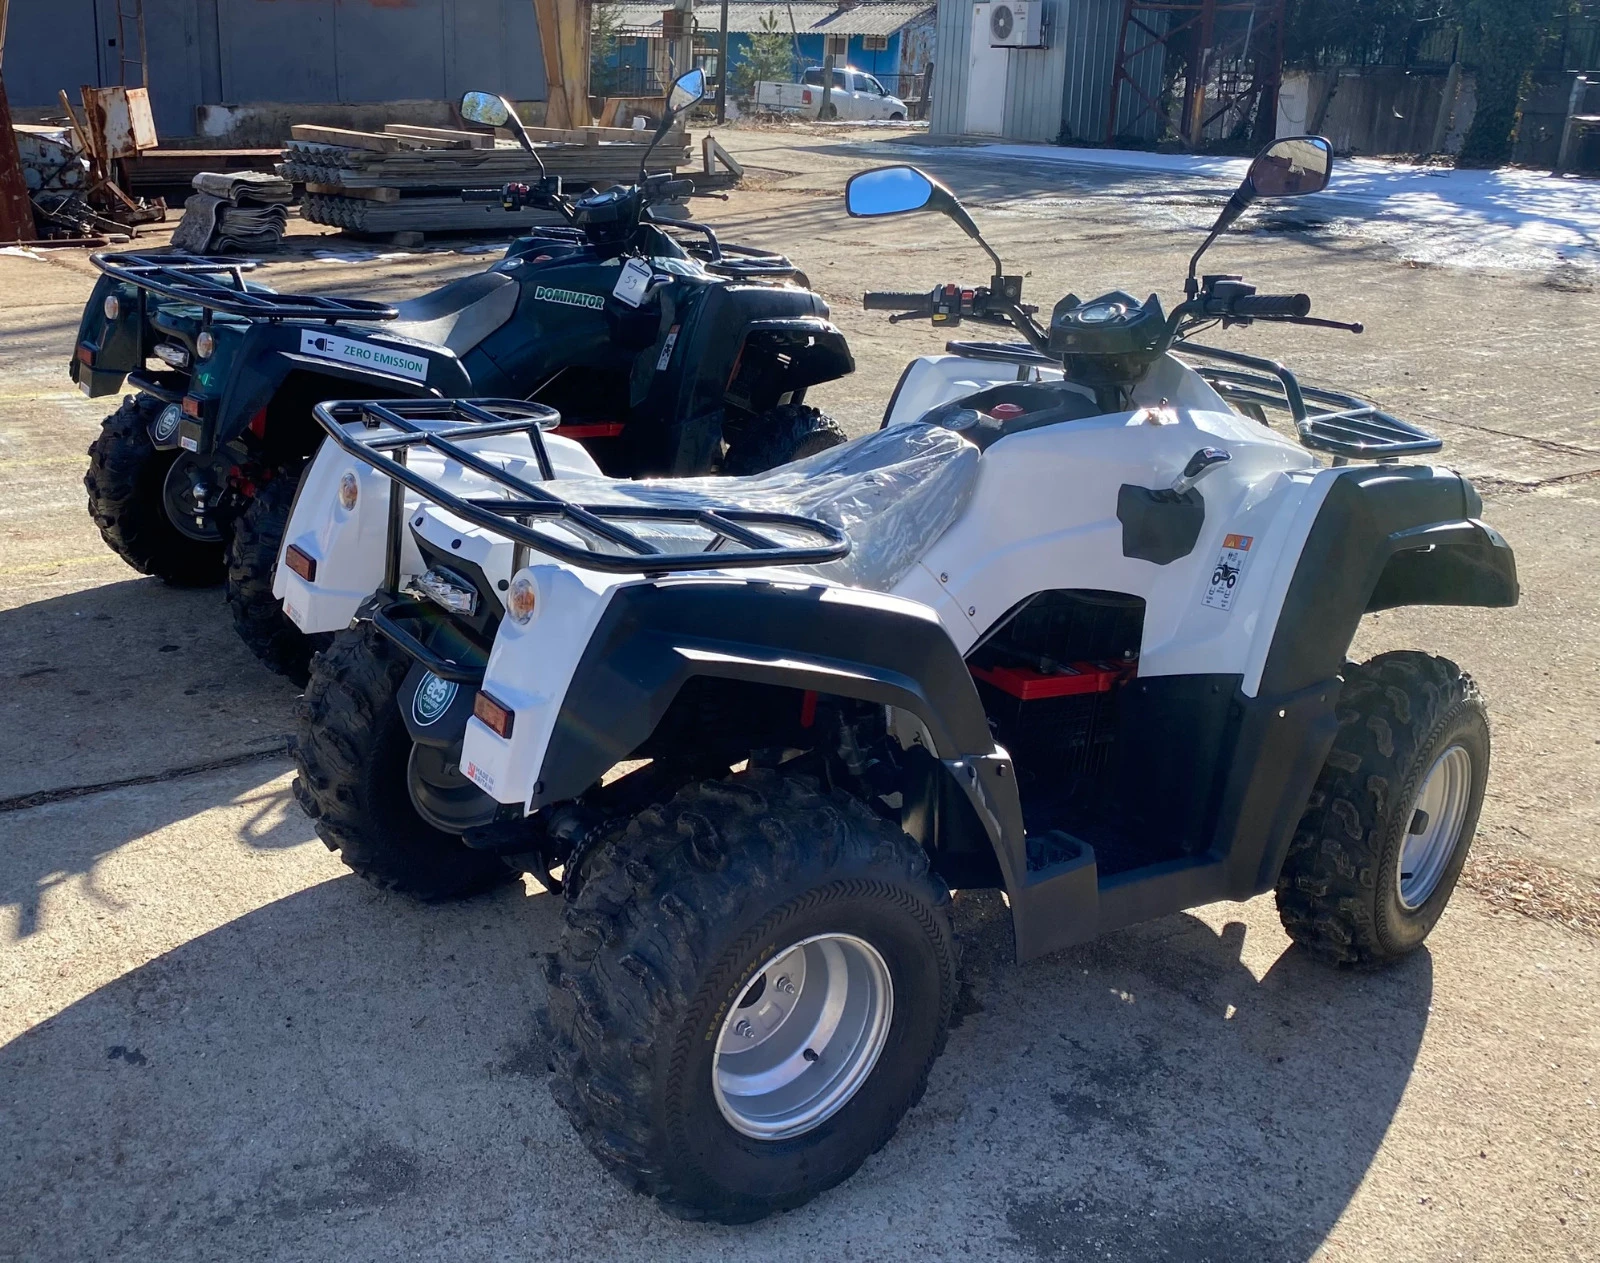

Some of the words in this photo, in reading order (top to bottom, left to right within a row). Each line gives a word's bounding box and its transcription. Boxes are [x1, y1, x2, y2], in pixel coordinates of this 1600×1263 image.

[535, 286, 605, 310] DOMINATOR
[343, 344, 371, 360] ZERO
[374, 352, 423, 373] EMISSION
[427, 681, 446, 703] eco
[704, 1001, 727, 1041] BEAR
[727, 959, 757, 998] CLAW
